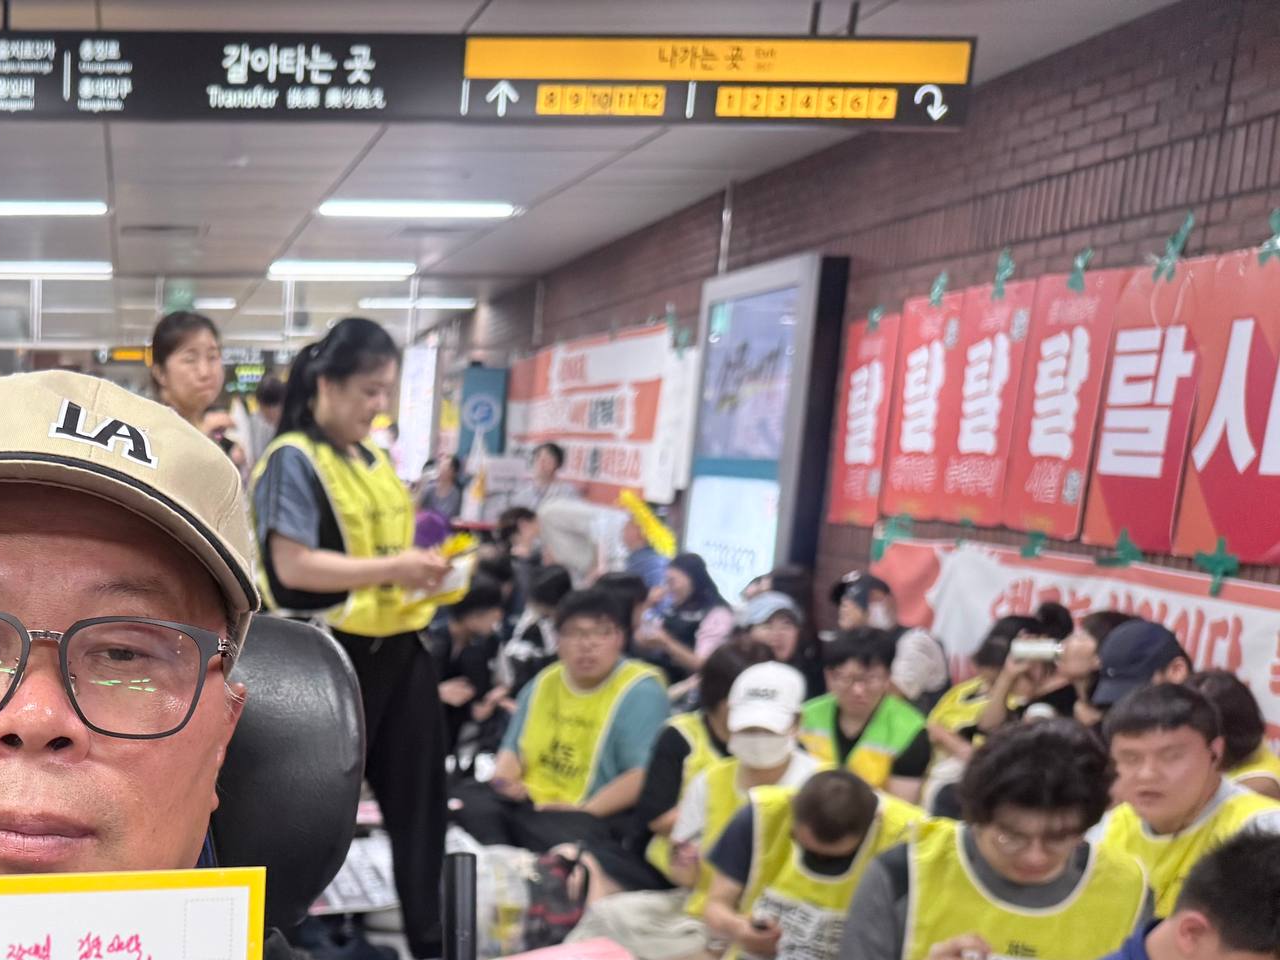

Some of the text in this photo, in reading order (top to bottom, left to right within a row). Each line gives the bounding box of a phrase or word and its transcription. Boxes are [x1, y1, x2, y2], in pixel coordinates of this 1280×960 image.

[222, 43, 376, 85] 갈아타는 곳
[658, 45, 719, 71] 나가는
[725, 46, 744, 70] 곳
[546, 91, 557, 108] 8
[592, 92, 611, 110] 10
[619, 92, 633, 110] 11
[643, 92, 659, 110] 12
[751, 93, 761, 111] 2
[800, 94, 812, 110] 4
[826, 95, 838, 112] 5
[850, 96, 862, 112] 6
[877, 95, 890, 112] 7
[900, 339, 944, 454] 탈
[957, 332, 1010, 456] 탈
[1028, 325, 1090, 459] 탈
[49, 400, 158, 468] LA
